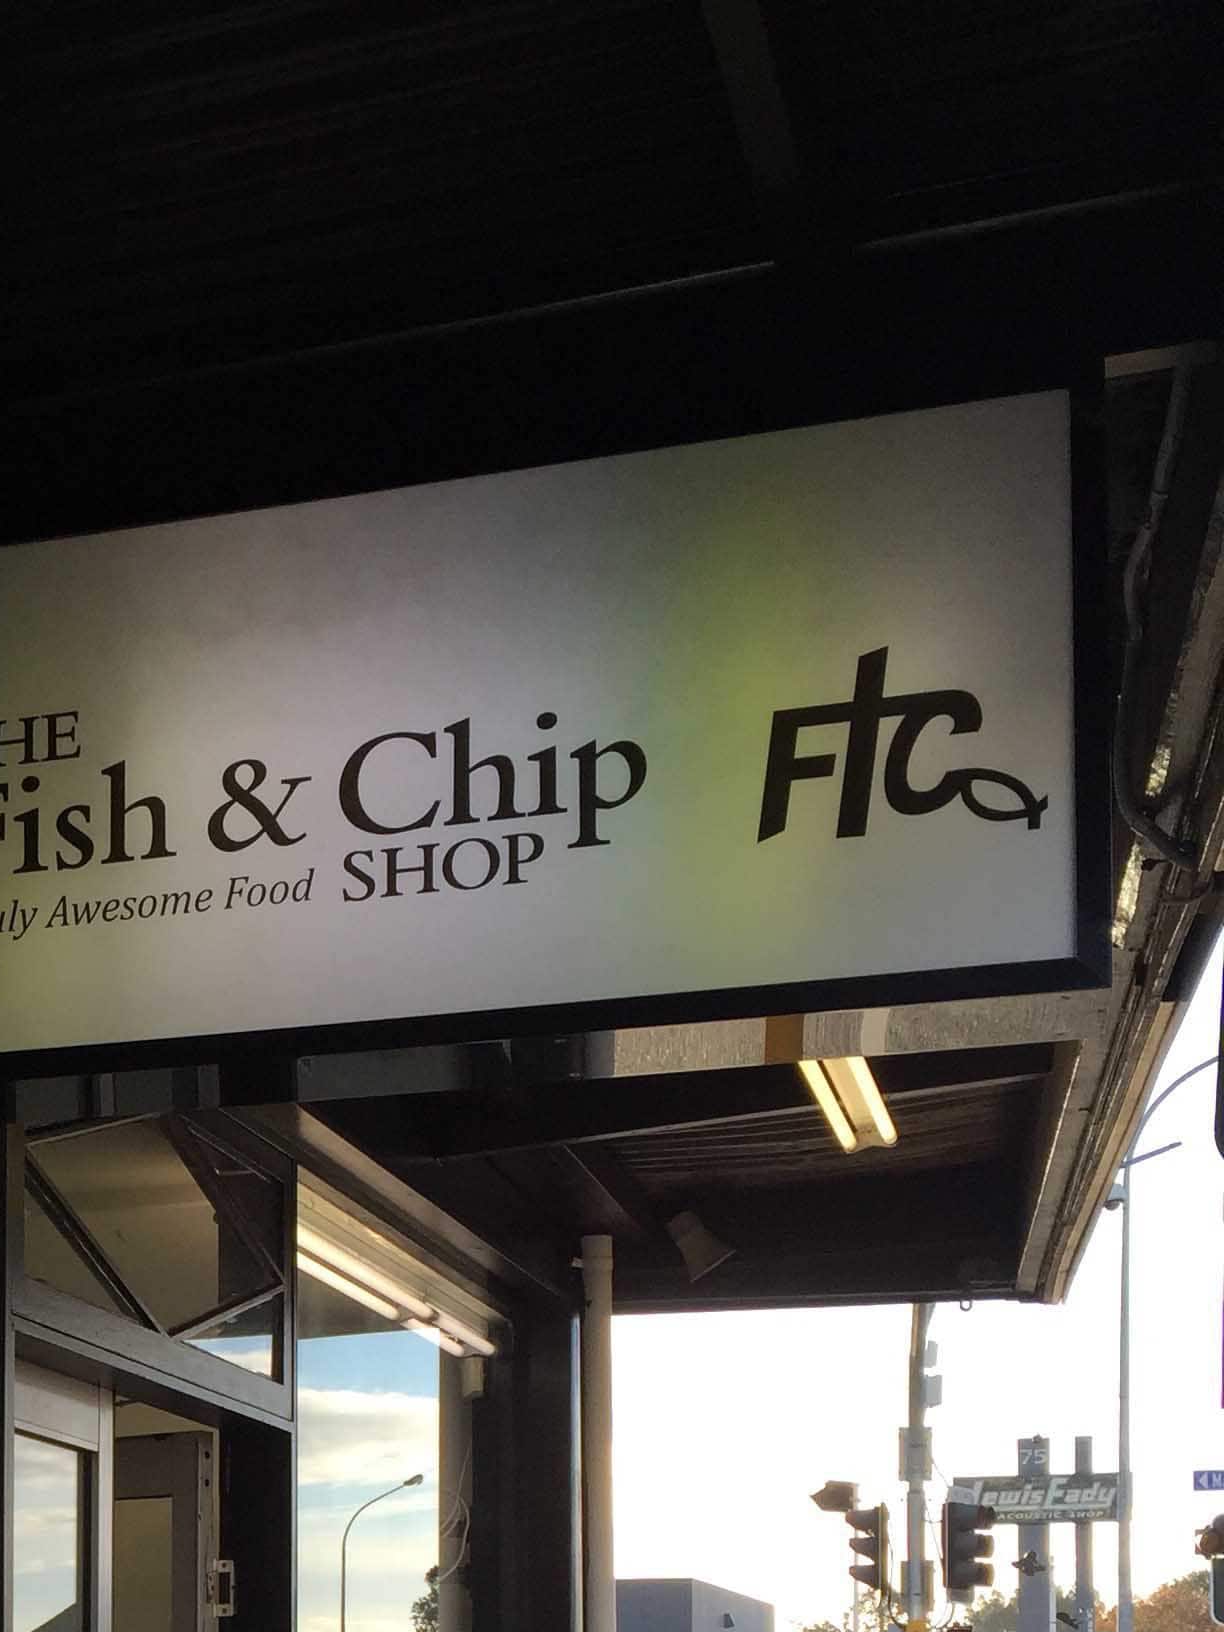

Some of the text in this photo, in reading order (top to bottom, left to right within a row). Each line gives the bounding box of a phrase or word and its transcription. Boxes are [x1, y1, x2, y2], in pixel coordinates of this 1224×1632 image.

[207, 759, 312, 852] &
[339, 712, 647, 848] Chip
[343, 832, 544, 902] SHOP
[45, 889, 213, 928] Awesome
[224, 868, 315, 909] Food
[1021, 1449, 1048, 1465] 75
[997, 1510, 1104, 1521] ACOUSTIC SHOP
